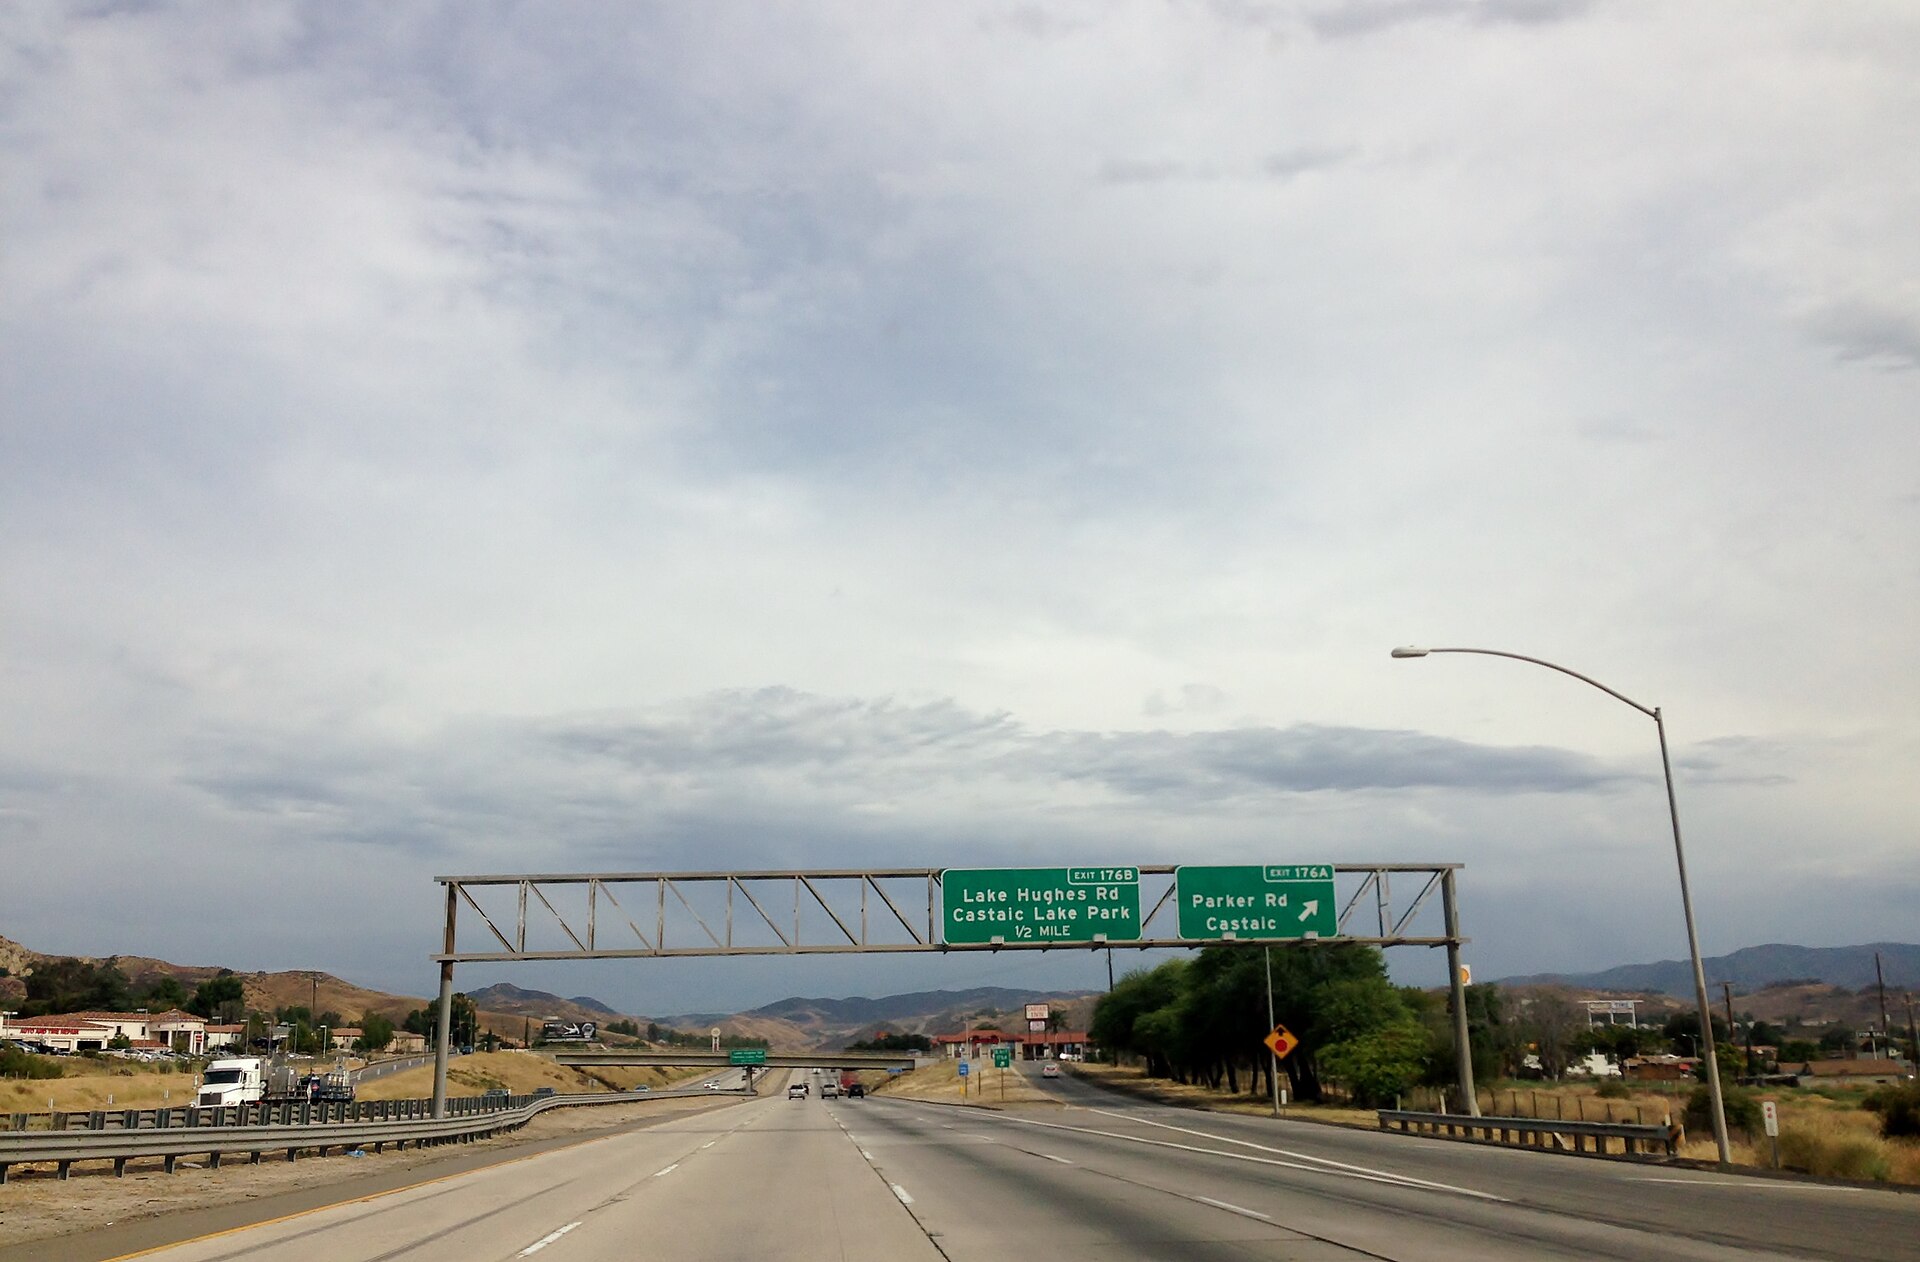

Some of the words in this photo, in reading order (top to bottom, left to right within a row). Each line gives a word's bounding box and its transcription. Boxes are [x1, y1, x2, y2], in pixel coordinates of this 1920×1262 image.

[1074, 871, 1095, 880] EXIT
[1100, 869, 1133, 881] 176B
[1269, 868, 1290, 877] EXIT
[1294, 867, 1328, 878] 176A
[963, 888, 1008, 903] Lake
[1017, 887, 1087, 905] Hughes
[1096, 886, 1119, 901] Rd
[1192, 894, 1255, 908] Parker
[1264, 893, 1288, 907] Rd
[953, 907, 1024, 922] Castaic
[1034, 906, 1078, 921] Lake
[1087, 905, 1131, 920] Park
[1206, 916, 1277, 931] Castaic
[1014, 925, 1032, 938] 1/2
[1039, 925, 1071, 937] MILE
